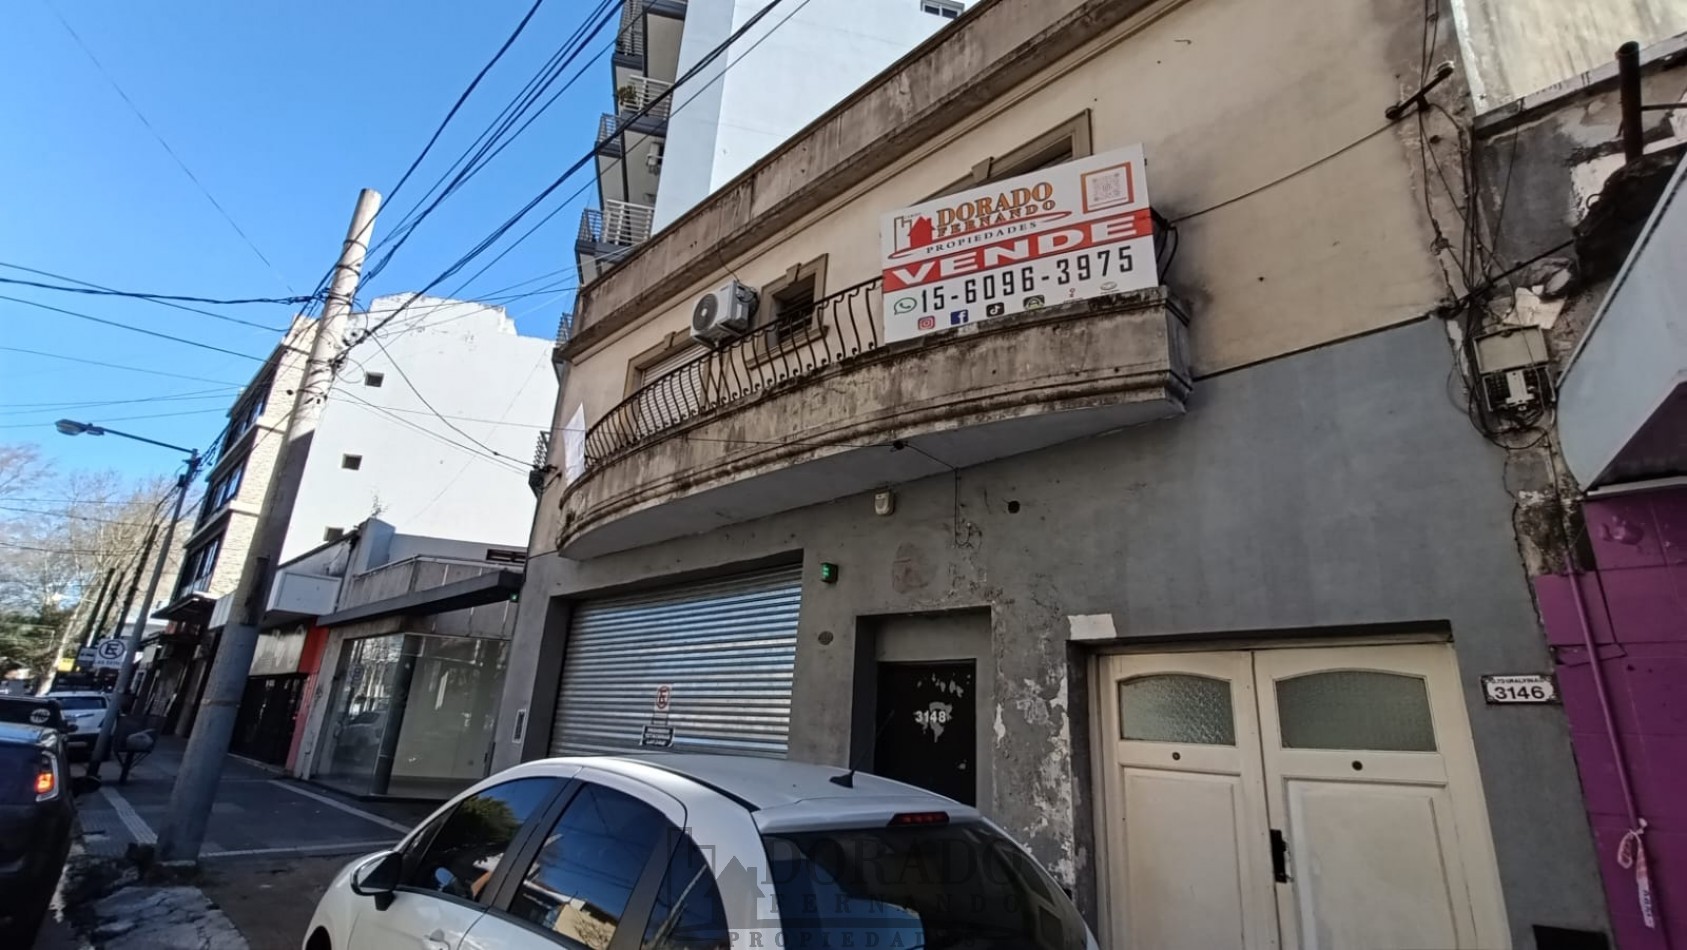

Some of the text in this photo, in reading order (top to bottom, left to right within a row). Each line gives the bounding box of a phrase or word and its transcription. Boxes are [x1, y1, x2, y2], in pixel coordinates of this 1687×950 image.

[936, 181, 1054, 227] DORADO
[936, 199, 1056, 237] FERNANDO
[892, 215, 1138, 285] VENDE
[926, 221, 1038, 254] PROPIEDADES
[921, 246, 1133, 313] 15-6096-3975
[1494, 686, 1545, 700] 3146
[913, 710, 946, 723] 3148
